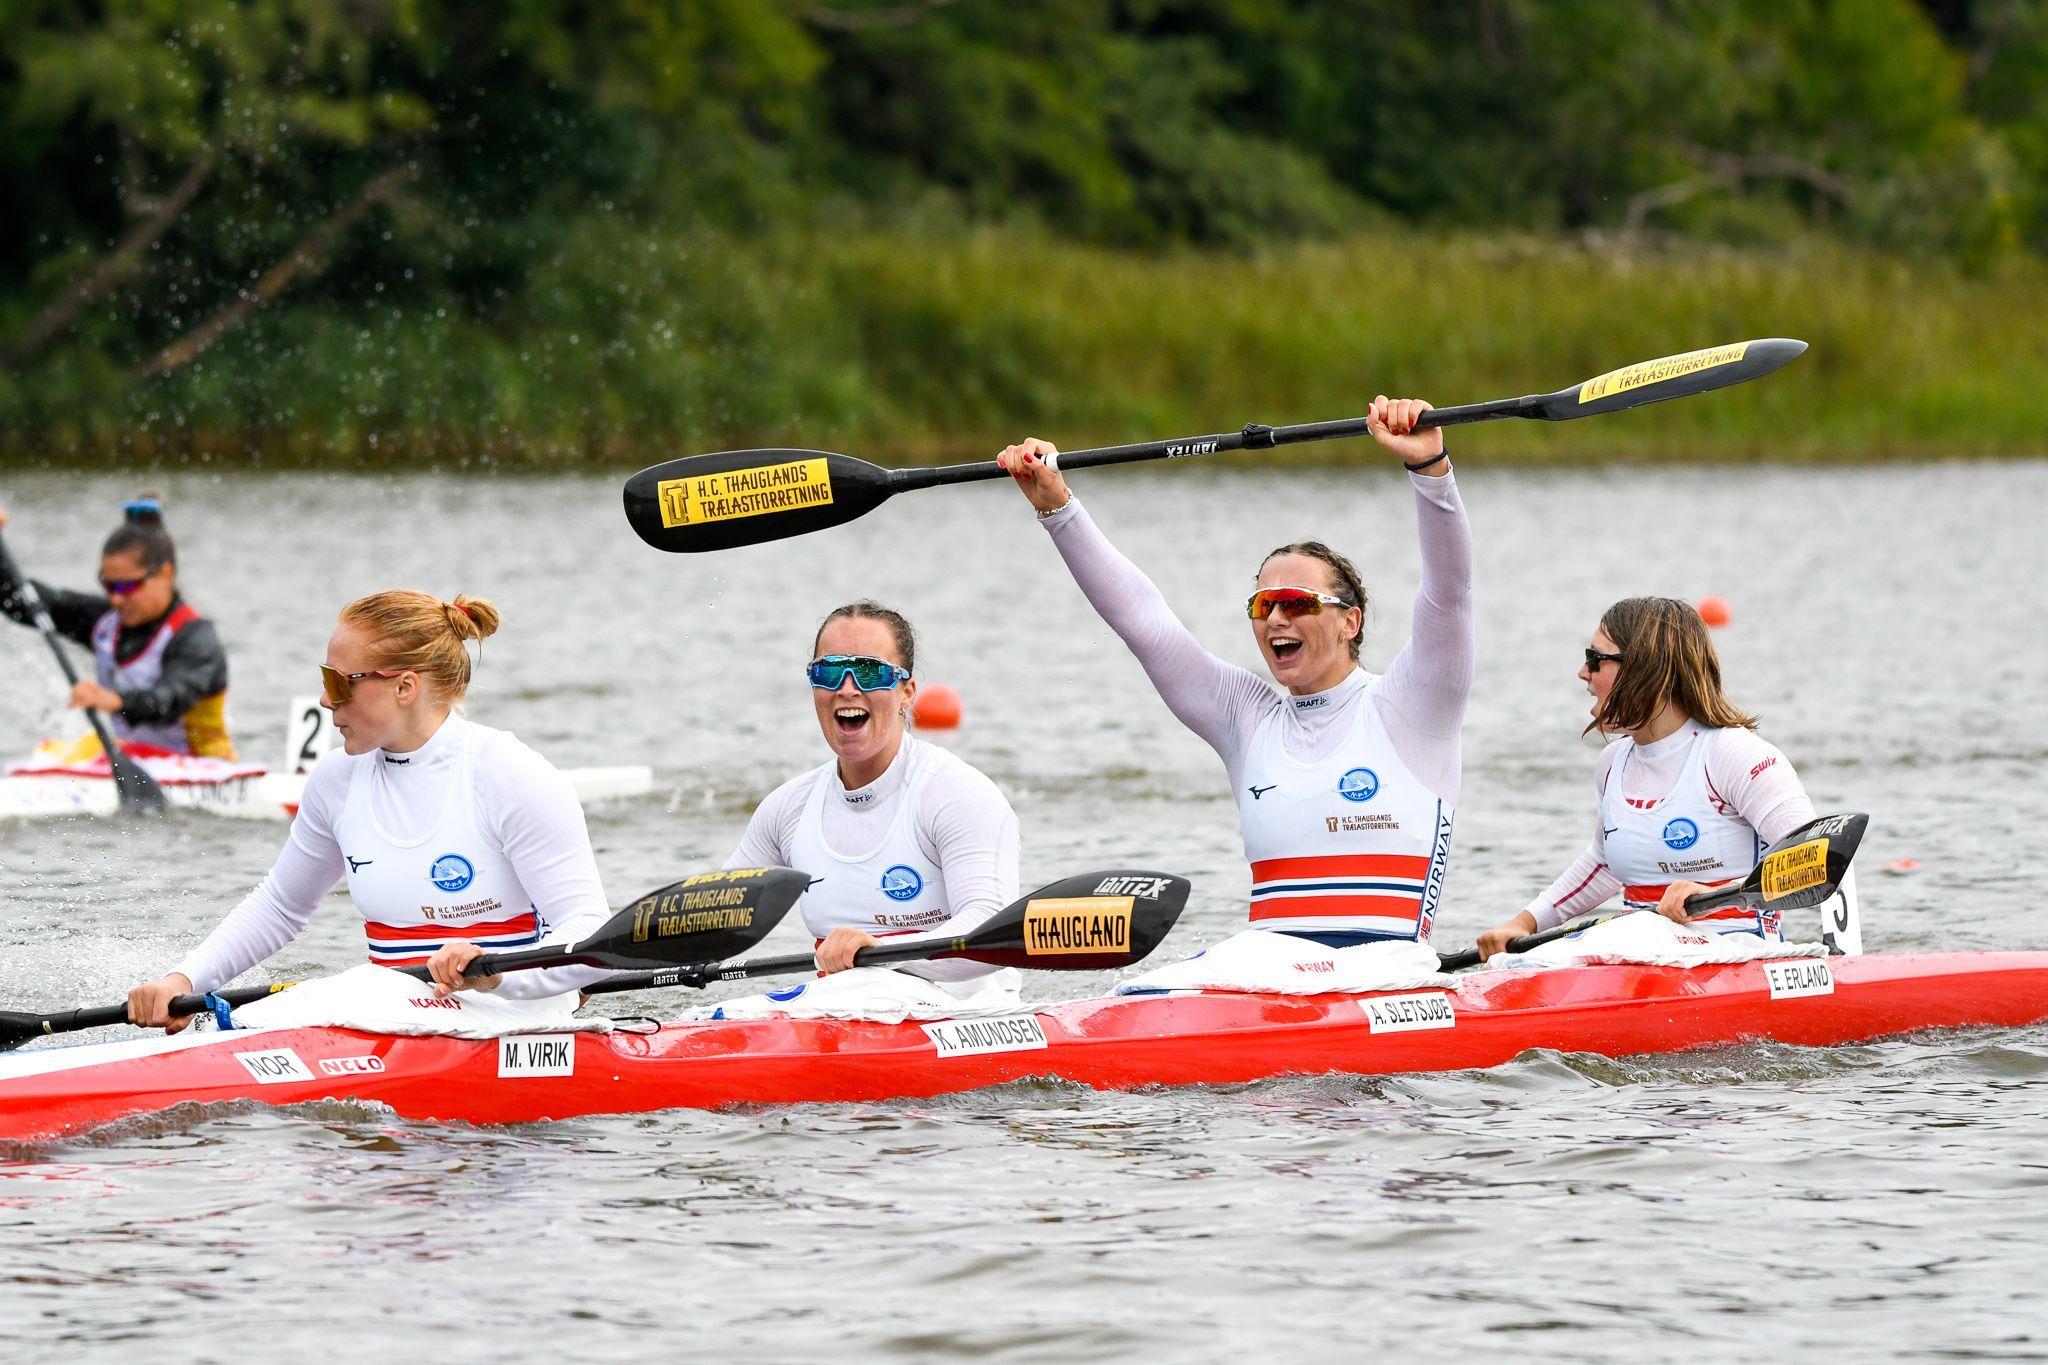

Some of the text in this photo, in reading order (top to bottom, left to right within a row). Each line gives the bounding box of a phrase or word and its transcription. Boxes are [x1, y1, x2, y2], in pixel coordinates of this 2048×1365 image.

[698, 465, 808, 498] H.C. THAUGLANDS
[700, 483, 830, 519] TRÆLASTFORRETNING
[1295, 698, 1320, 708] CRAFT
[300, 707, 321, 760] 2
[1354, 814, 1392, 822] THAUGLANDS
[1424, 815, 1451, 917] NORWAY
[451, 898, 494, 912] THAUGLANDS
[661, 887, 748, 913] H.C. THAUGLANDS
[657, 907, 755, 937] TRÆLASTFORRETNING
[902, 908, 943, 921] THAUGLANDS
[1028, 914, 1126, 949] THAUGLAND
[1769, 964, 1829, 991] E. ERLAND
[1370, 998, 1452, 1025] A. SLETSJØE
[931, 1018, 1044, 1050] K. AMUNDSEN
[245, 1055, 300, 1077] NOR
[322, 1057, 381, 1073] NELO
[505, 1042, 569, 1068] M. VIRIK
